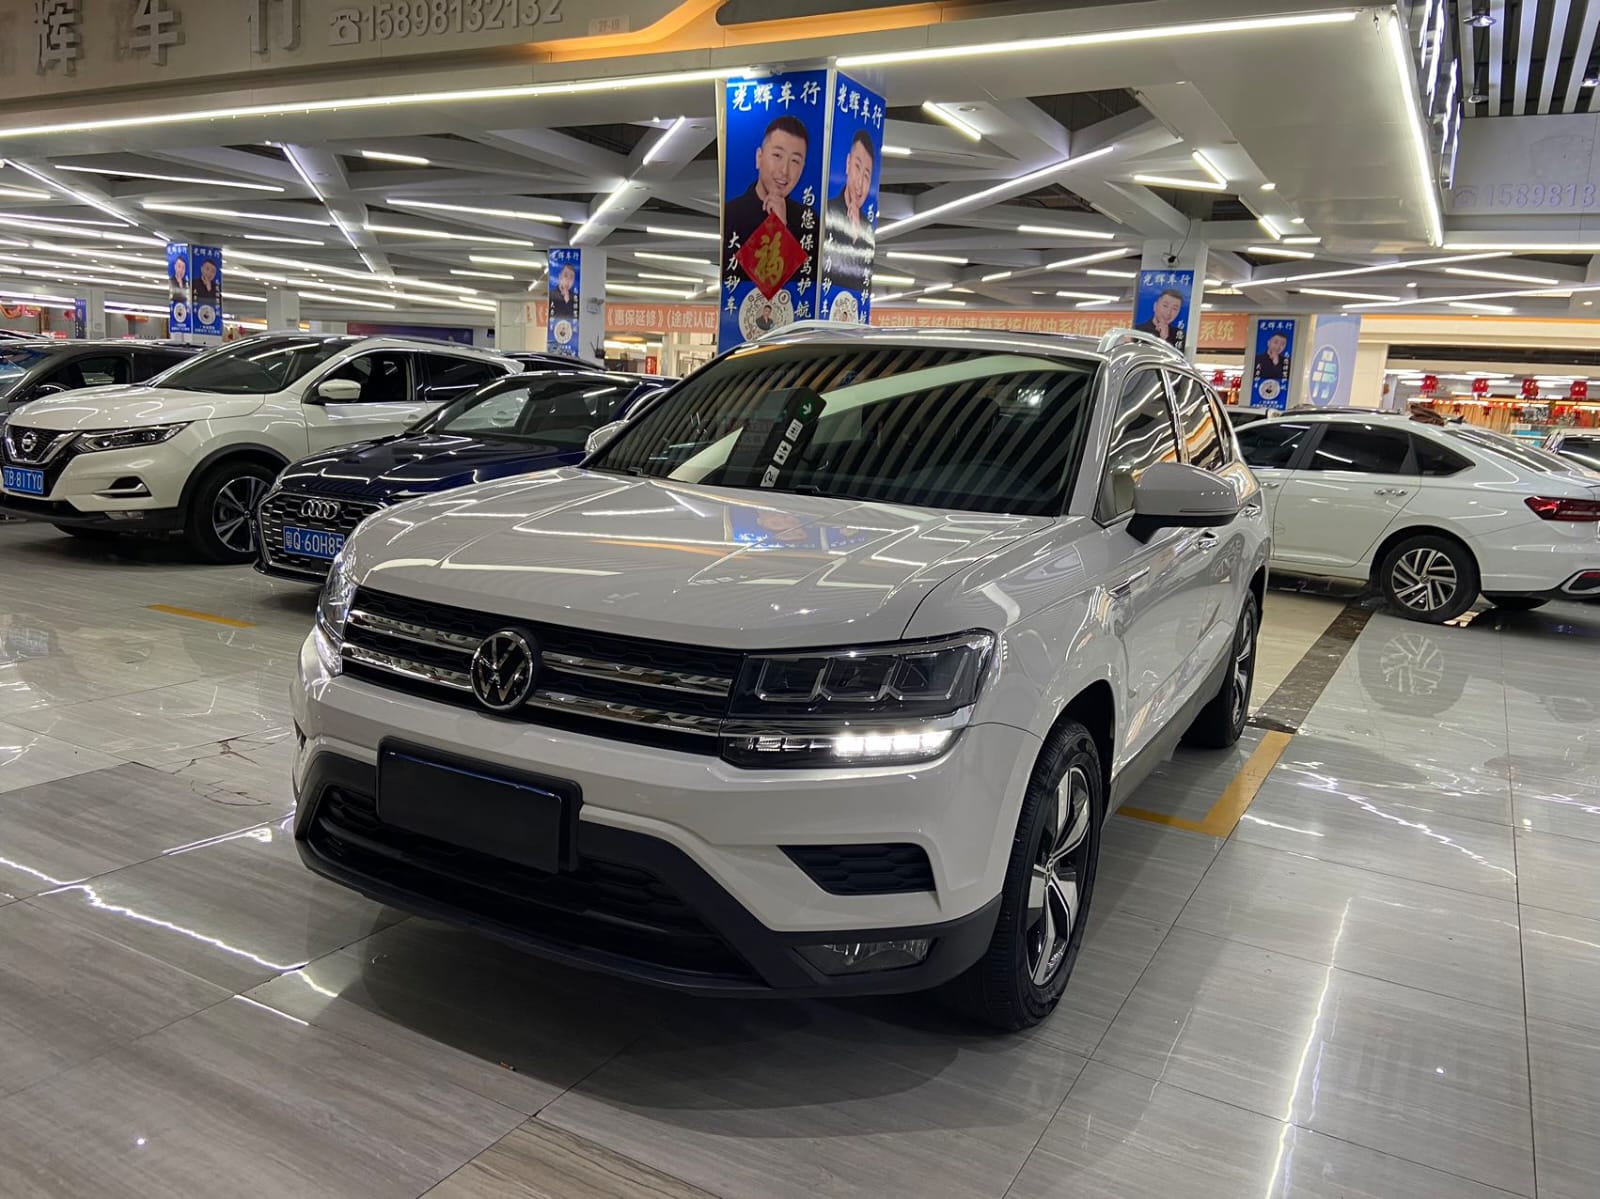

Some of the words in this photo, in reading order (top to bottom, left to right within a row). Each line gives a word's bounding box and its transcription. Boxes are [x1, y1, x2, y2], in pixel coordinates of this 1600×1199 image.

[732, 80, 821, 112] 光辉车行
[837, 83, 883, 130] 光辉车行
[754, 232, 785, 286] 福
